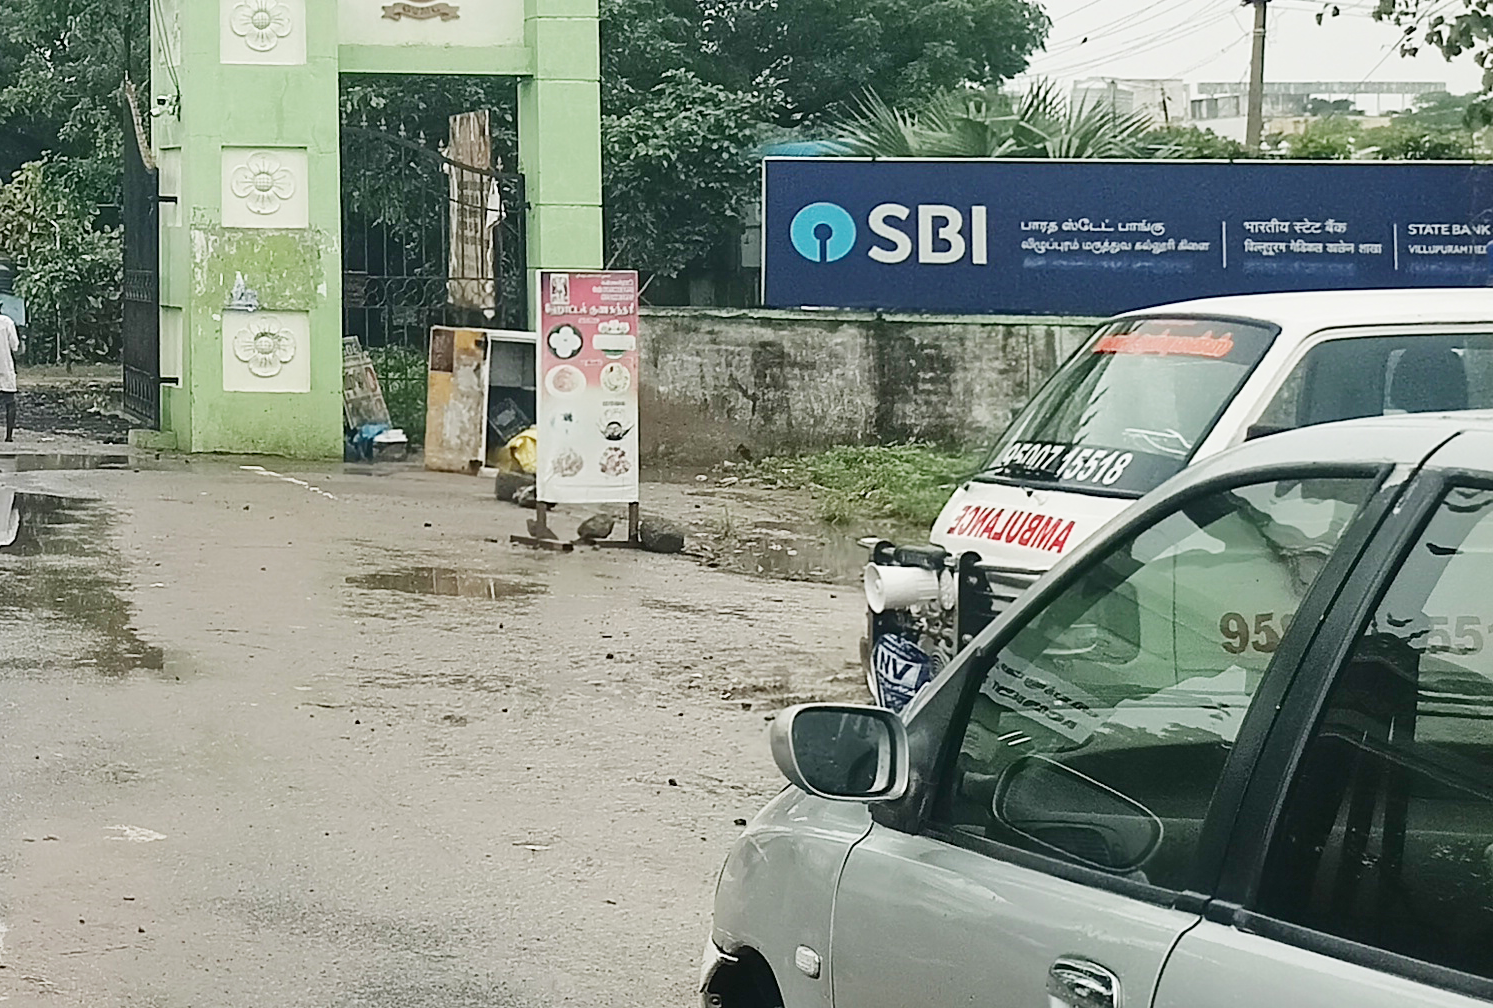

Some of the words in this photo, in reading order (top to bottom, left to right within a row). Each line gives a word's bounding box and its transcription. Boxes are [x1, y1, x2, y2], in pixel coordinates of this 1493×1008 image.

[867, 202, 987, 265] SBI
[1020, 220, 1058, 234] பாரத
[1243, 218, 1290, 233] भारतीय
[1293, 218, 1322, 234] स्टेट
[1408, 224, 1450, 236] STATE
[1452, 225, 1492, 236] BANK
[1054, 445, 1133, 485] 15518
